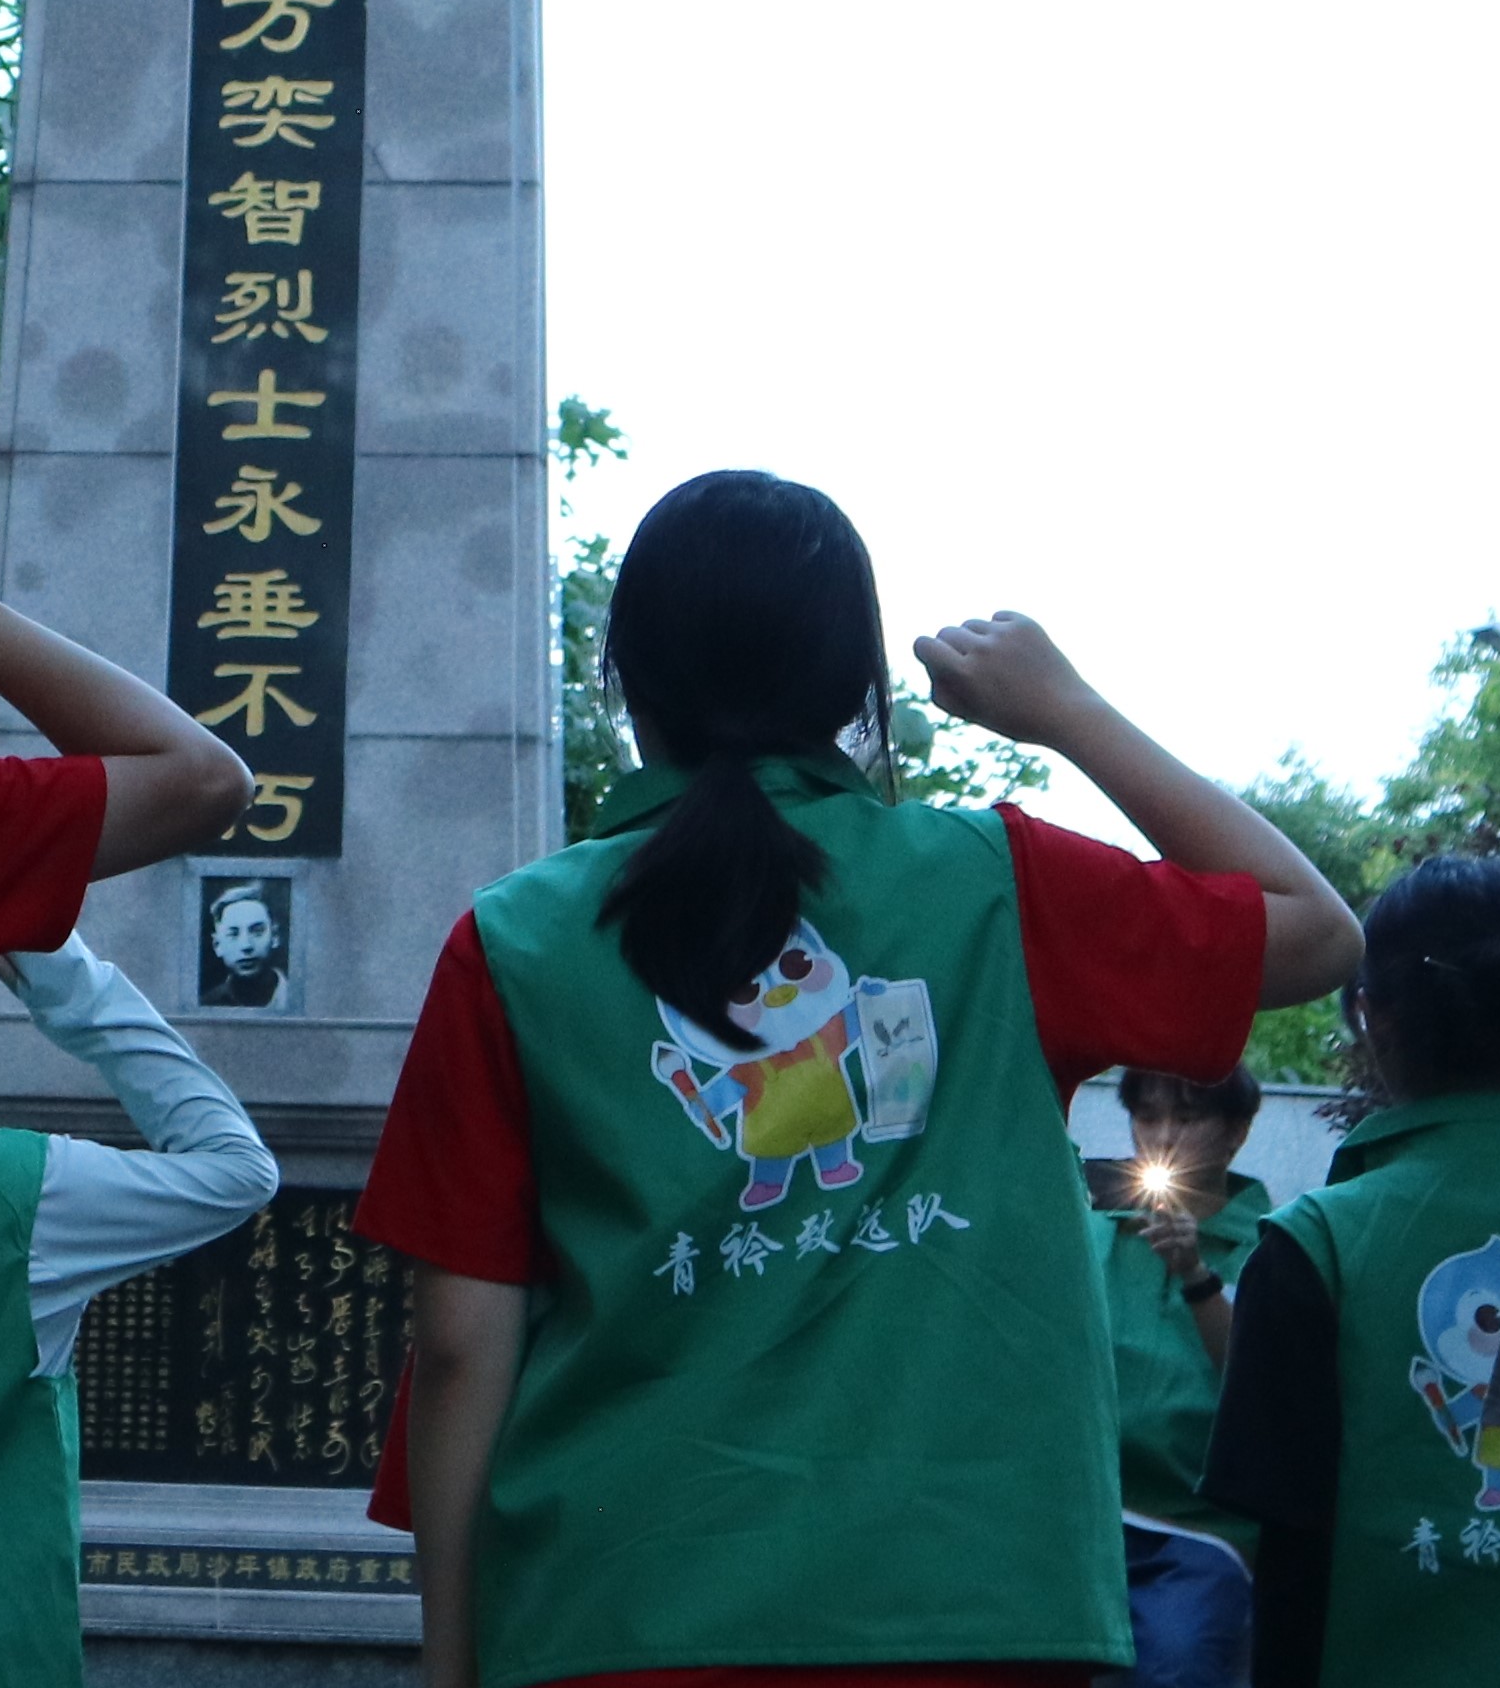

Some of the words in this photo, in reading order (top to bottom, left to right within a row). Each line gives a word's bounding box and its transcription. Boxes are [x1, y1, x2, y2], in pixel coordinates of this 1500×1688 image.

[653, 1192, 970, 1296] 青衿致远队
